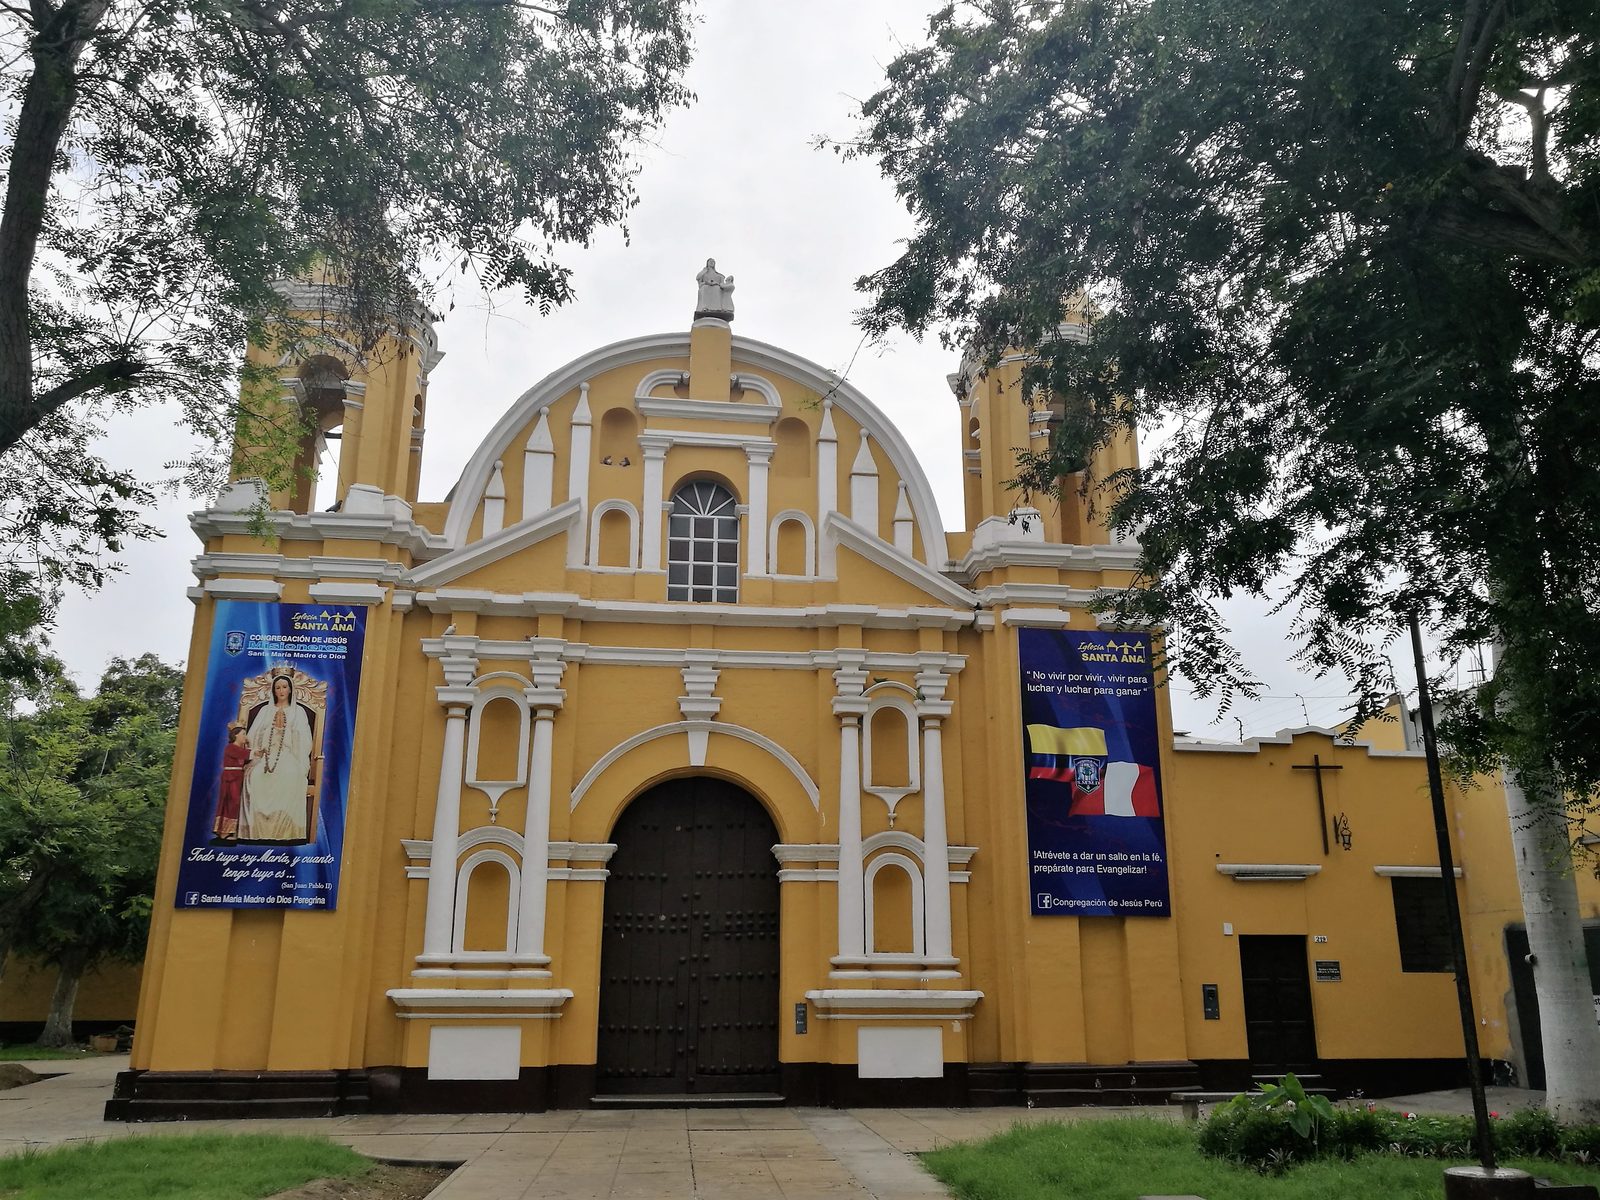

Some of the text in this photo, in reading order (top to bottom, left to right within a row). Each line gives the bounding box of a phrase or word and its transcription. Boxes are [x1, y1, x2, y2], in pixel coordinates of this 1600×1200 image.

[292, 612, 318, 622] Iglesia
[294, 622, 354, 631] SANTA ANA
[250, 634, 311, 643] CONGREGACIÓN
[248, 641, 348, 652] Misioneros
[1078, 642, 1104, 652] Iglesia
[1082, 653, 1144, 663] SANTA ANA
[1033, 671, 1046, 680] No
[1048, 672, 1066, 680] vivir
[1068, 673, 1082, 682] por
[1085, 673, 1106, 683] vivir,
[1108, 674, 1126, 682] vivir
[1128, 676, 1147, 684] para
[1027, 683, 1055, 692] luchar
[1057, 686, 1062, 694] y
[1065, 685, 1092, 694] luchar
[1094, 687, 1114, 696] para
[1116, 688, 1141, 697] ganar
[188, 848, 334, 867] Todo tuyo soy María, y cuanto
[1033, 850, 1070, 860] !Atrévete
[1108, 852, 1128, 861] salto
[1143, 853, 1150, 861] la
[1152, 853, 1162, 862] fé,
[222, 868, 250, 882] tengo
[251, 868, 274, 882] tuyo
[1034, 864, 1147, 875] prepárate para Evangelizar!
[201, 894, 221, 903] Santa
[243, 895, 265, 903] Madre
[293, 896, 326, 905] Peregrina
[1053, 898, 1106, 908] Congregación
